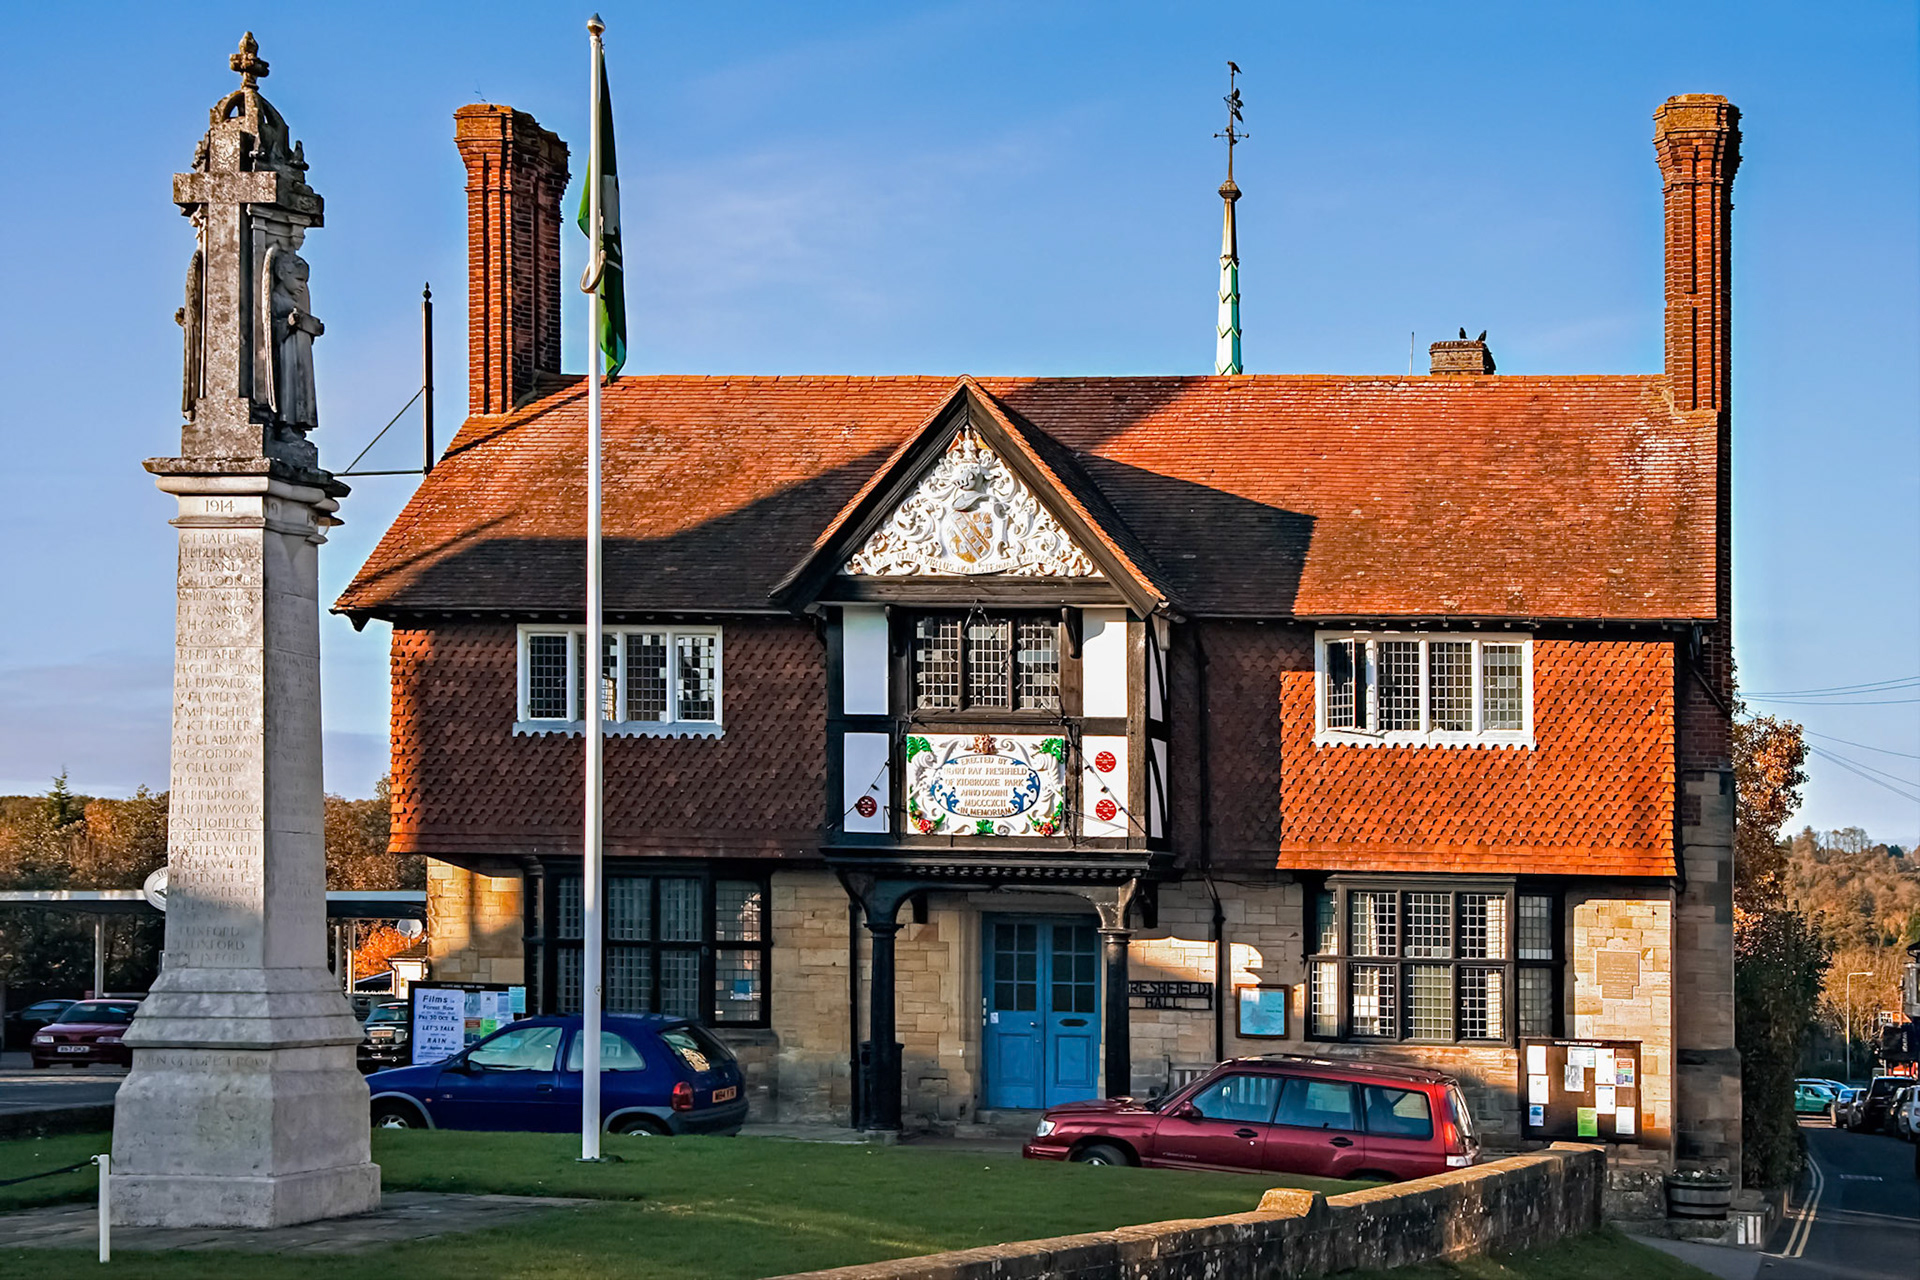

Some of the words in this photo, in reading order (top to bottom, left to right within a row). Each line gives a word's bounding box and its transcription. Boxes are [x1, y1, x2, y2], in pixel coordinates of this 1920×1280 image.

[205, 499, 235, 512] 1914
[961, 757, 994, 765] ERECTED
[944, 767, 966, 775] HENRY
[968, 767, 983, 775] RAY
[985, 767, 1027, 775] FRESHFIELD
[961, 789, 981, 797] ANNO
[982, 789, 1008, 797] DOMINI
[970, 807, 1012, 816] MEMORIAM
[1129, 982, 1208, 995] RESHFIELD
[422, 995, 448, 1003] Films
[1146, 996, 1182, 1009] HALL
